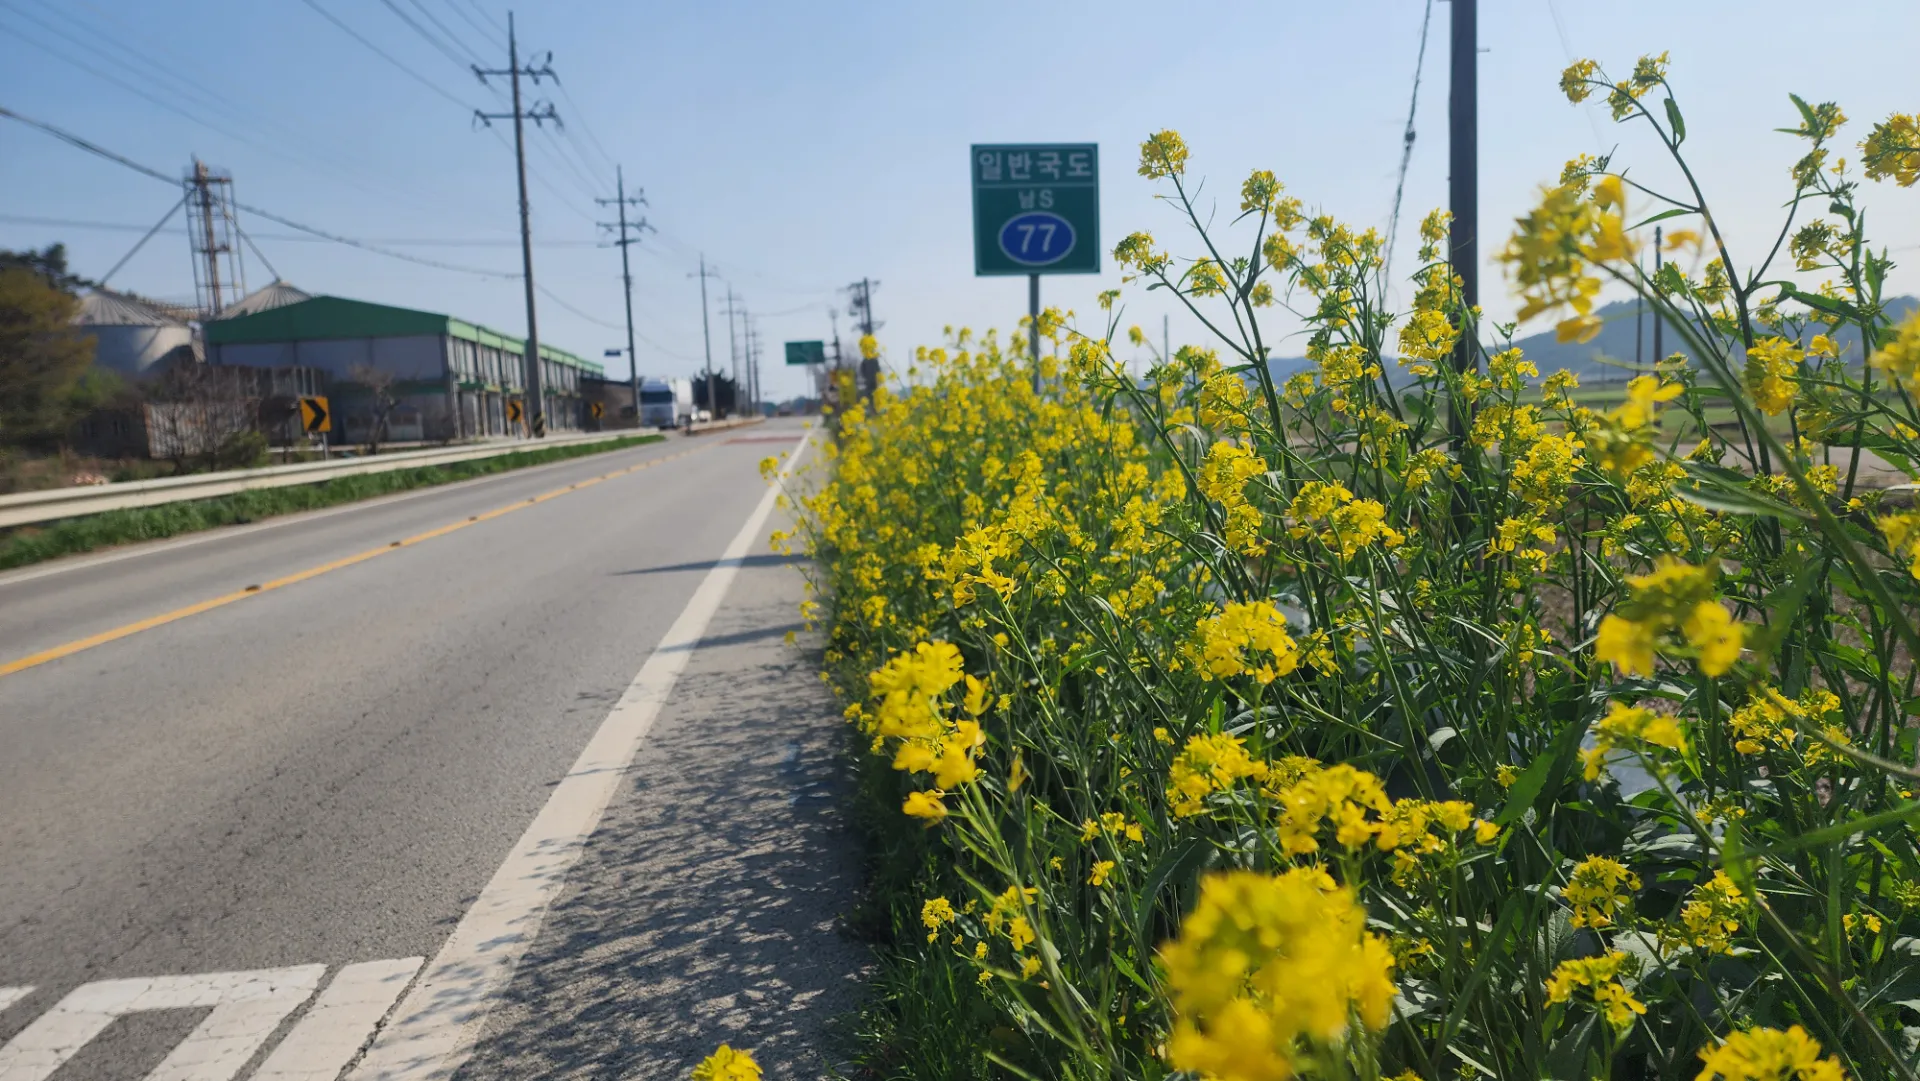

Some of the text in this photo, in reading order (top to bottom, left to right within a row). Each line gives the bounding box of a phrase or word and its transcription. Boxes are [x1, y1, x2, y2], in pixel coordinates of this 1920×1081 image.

[980, 152, 1092, 180] 일반국도
[1039, 189, 1054, 208] S
[1017, 224, 1056, 253] 77
